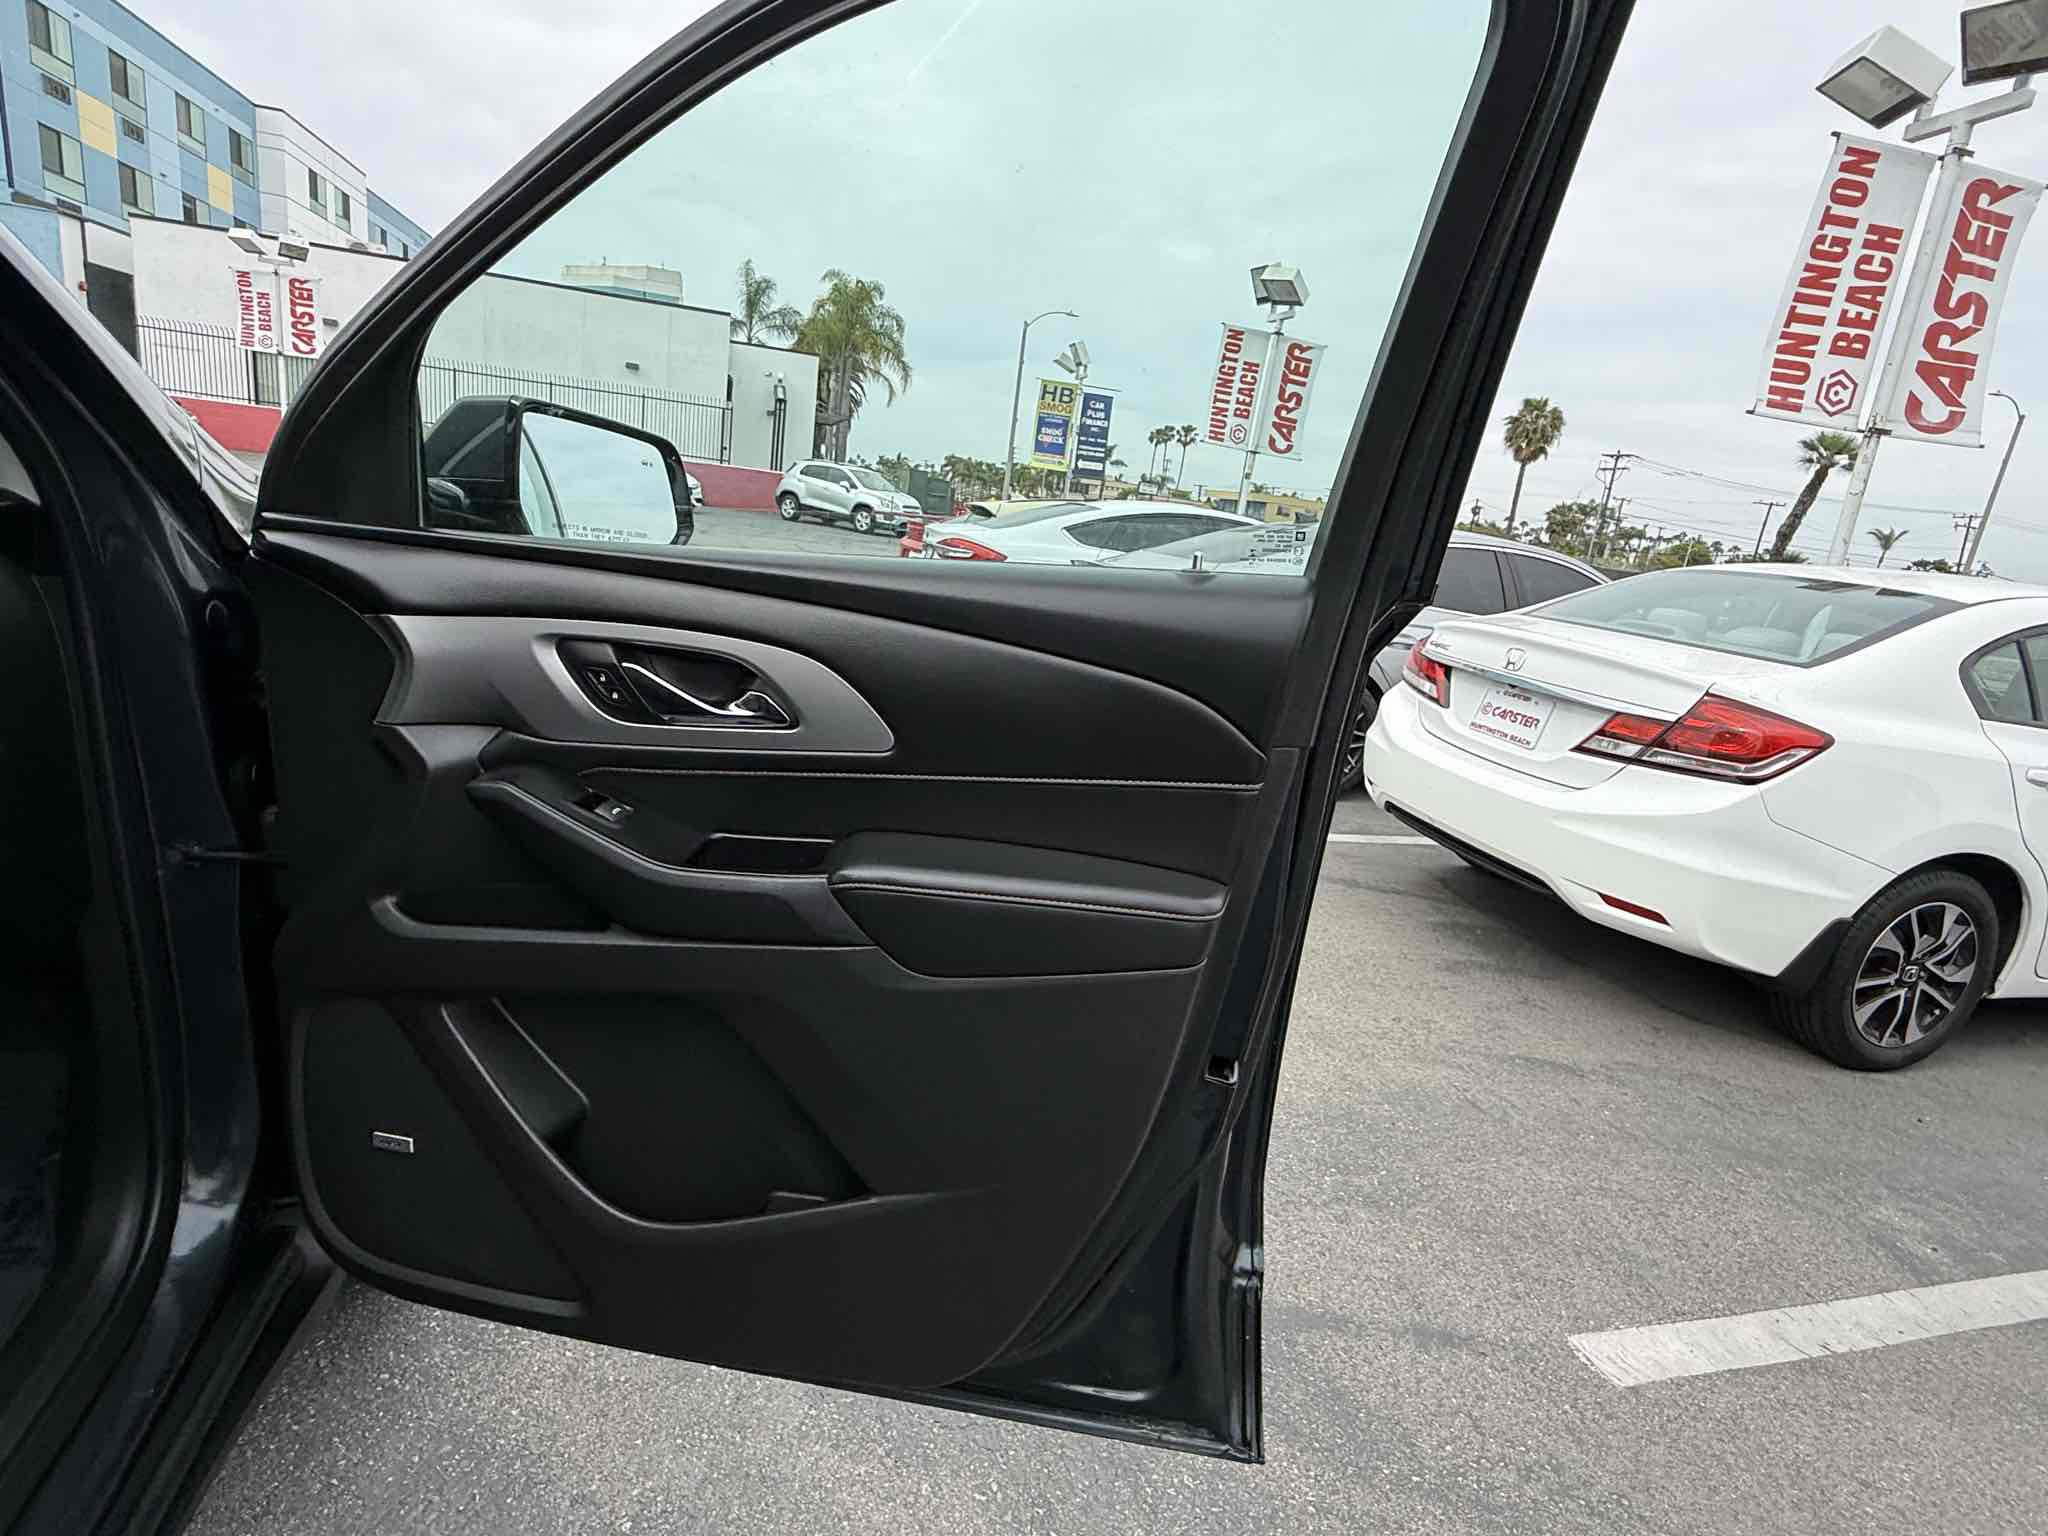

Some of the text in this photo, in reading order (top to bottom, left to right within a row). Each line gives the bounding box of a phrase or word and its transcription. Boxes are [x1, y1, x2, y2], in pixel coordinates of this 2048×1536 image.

[235, 270, 255, 347] HUNTINGTON
[256, 291, 272, 332] BEACH
[1766, 145, 1881, 413] HUNTINGTON
[1828, 223, 1904, 360] BEACH
[1904, 177, 2024, 435] CARSTER
[288, 277, 316, 355] CARSTER
[1039, 401, 1073, 415] SMOG
[1040, 383, 1075, 404] HB
[1086, 409, 1105, 419] PLUS
[1208, 328, 1245, 442] HUNTINGTON
[1233, 360, 1260, 419] BEACH
[1268, 341, 1314, 454] CARSTER
[1471, 721, 1531, 747] HUNTINGTON BEACH
[1491, 706, 1540, 730] CARSTER
